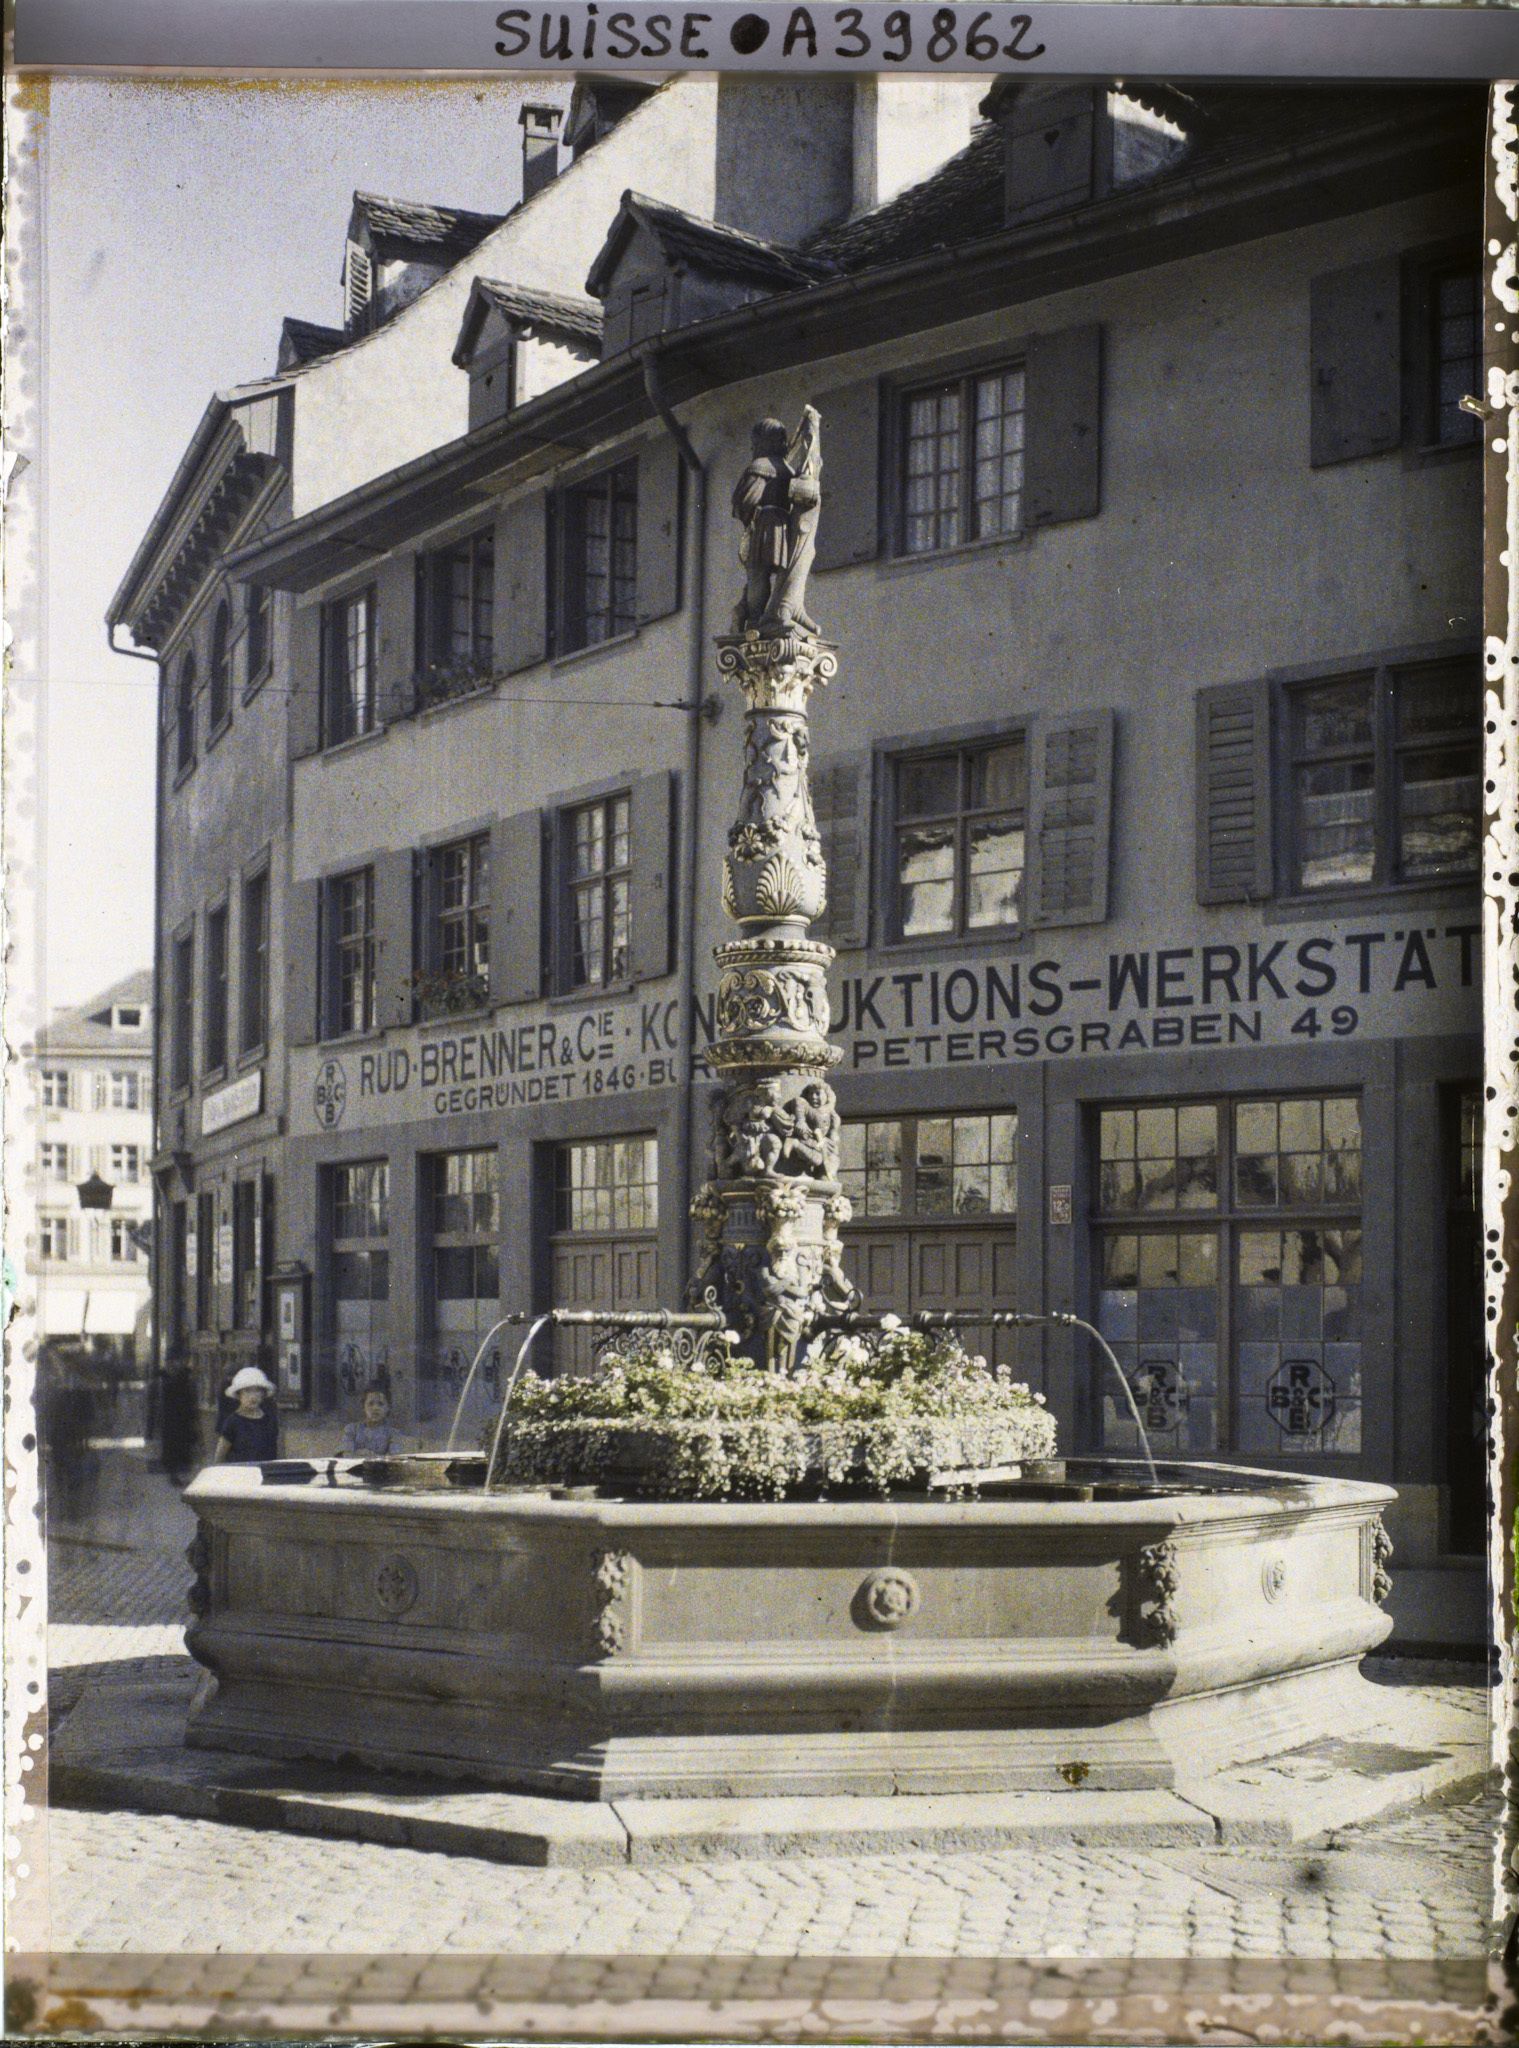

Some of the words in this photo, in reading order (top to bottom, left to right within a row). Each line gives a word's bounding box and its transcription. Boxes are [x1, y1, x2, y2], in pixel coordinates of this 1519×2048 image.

[782, 7, 1046, 62] A39862
[420, 1021, 557, 1088] BRENNER
[433, 1072, 577, 1115] GEGRÜNDET
[852, 1010, 1262, 1069] PETERSGRABEN
[1290, 1004, 1359, 1039] 49
